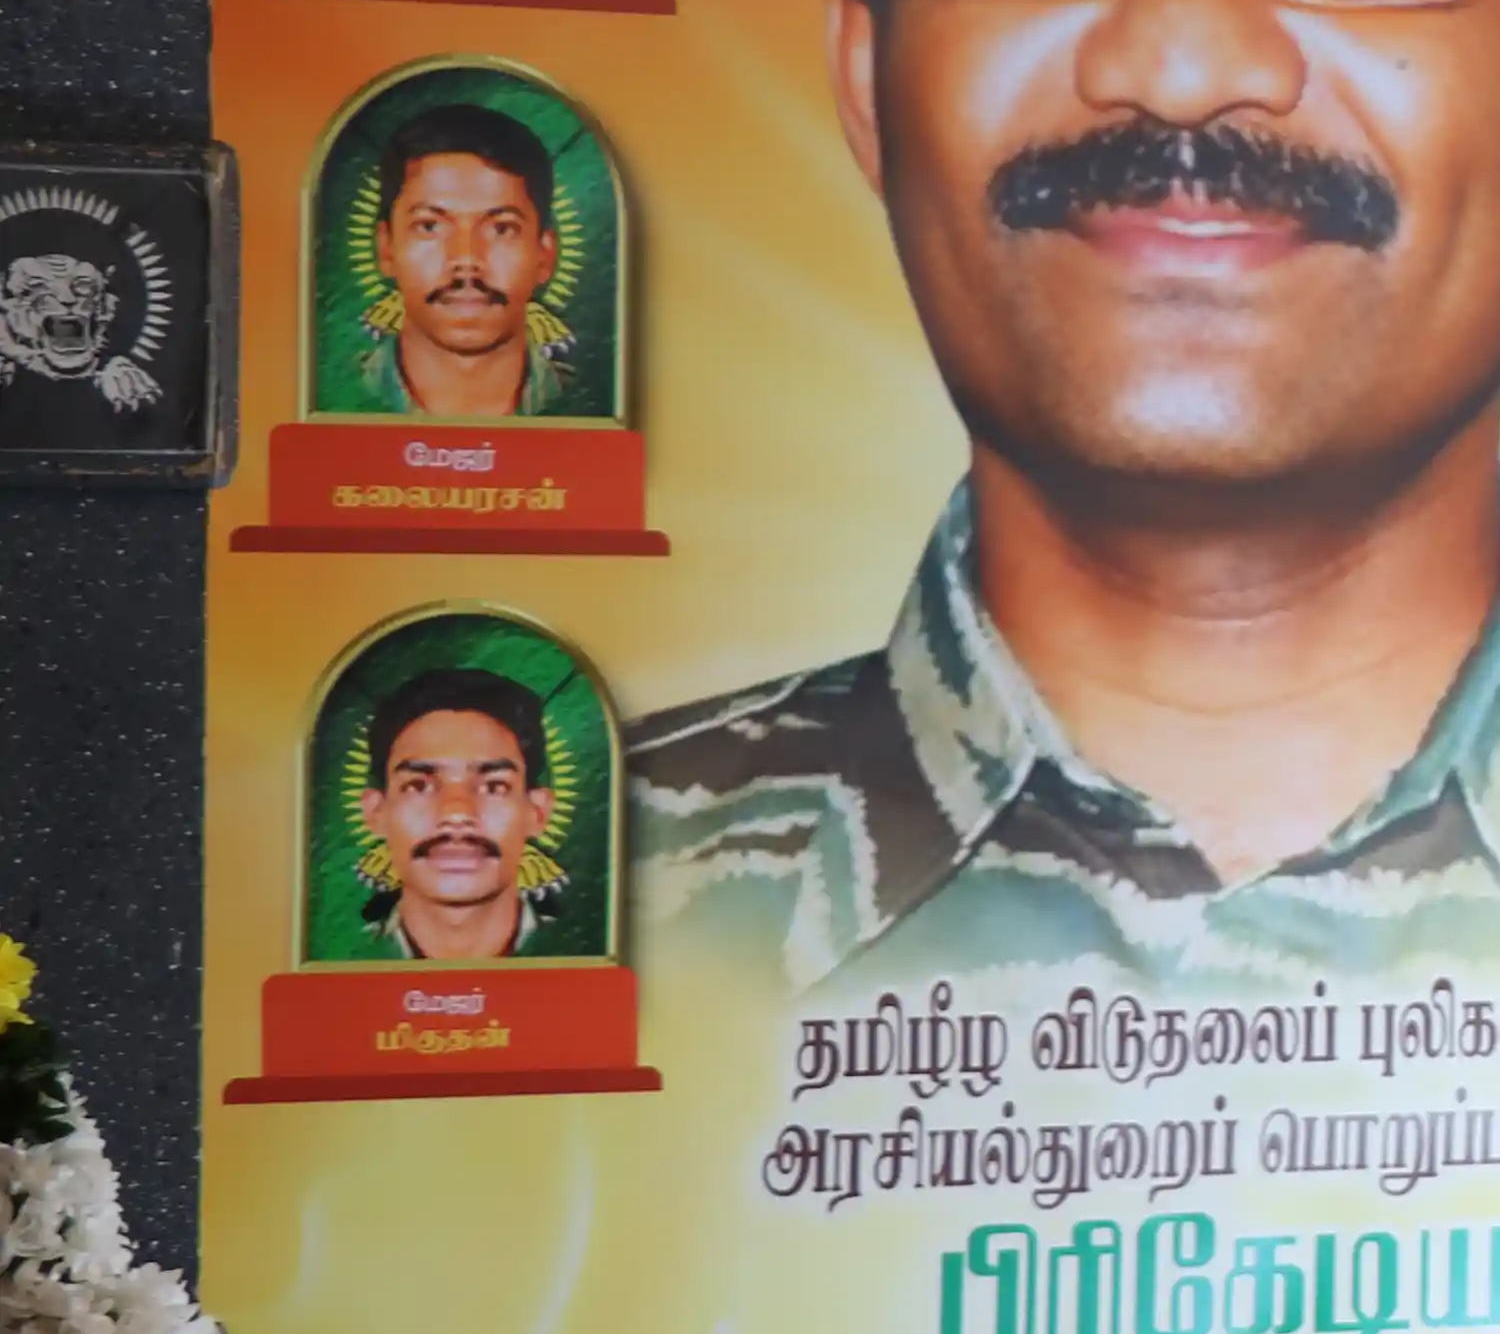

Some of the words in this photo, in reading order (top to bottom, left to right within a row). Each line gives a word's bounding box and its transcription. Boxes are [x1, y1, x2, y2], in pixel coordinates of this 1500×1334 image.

[404, 441, 496, 471] மேஜர்
[332, 478, 568, 514] கலையரசன்
[404, 987, 486, 1015] மேஜர்
[375, 1018, 512, 1054] மிகுதன்
[792, 980, 1008, 1101] தமிழீழ
[1031, 981, 1337, 1088] விடுதலைப்
[762, 1095, 1237, 1211] அரசியல்துறைப்
